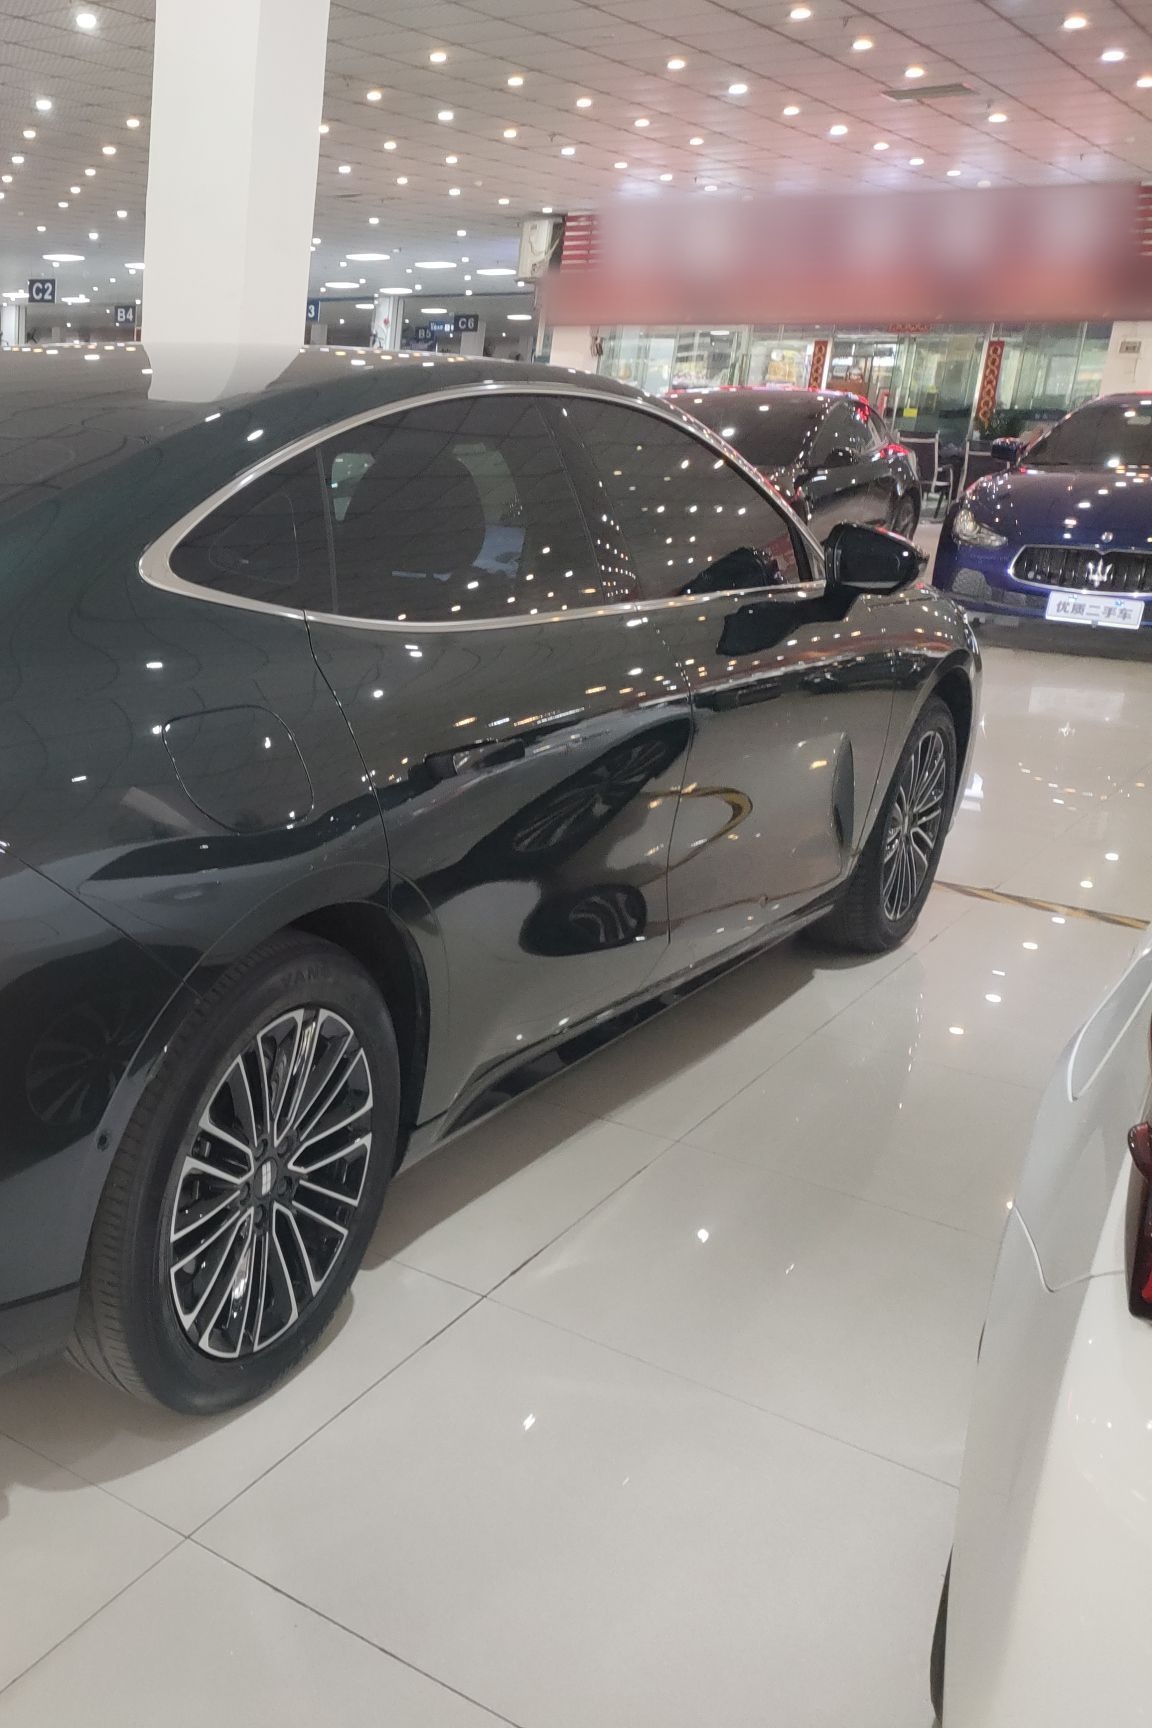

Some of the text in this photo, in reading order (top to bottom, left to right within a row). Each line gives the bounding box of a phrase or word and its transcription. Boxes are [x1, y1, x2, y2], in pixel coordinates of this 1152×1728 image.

[32, 282, 53, 300] C2
[117, 307, 134, 322] B4
[458, 317, 475, 329] C6
[1056, 601, 1134, 620] 优质二手车
